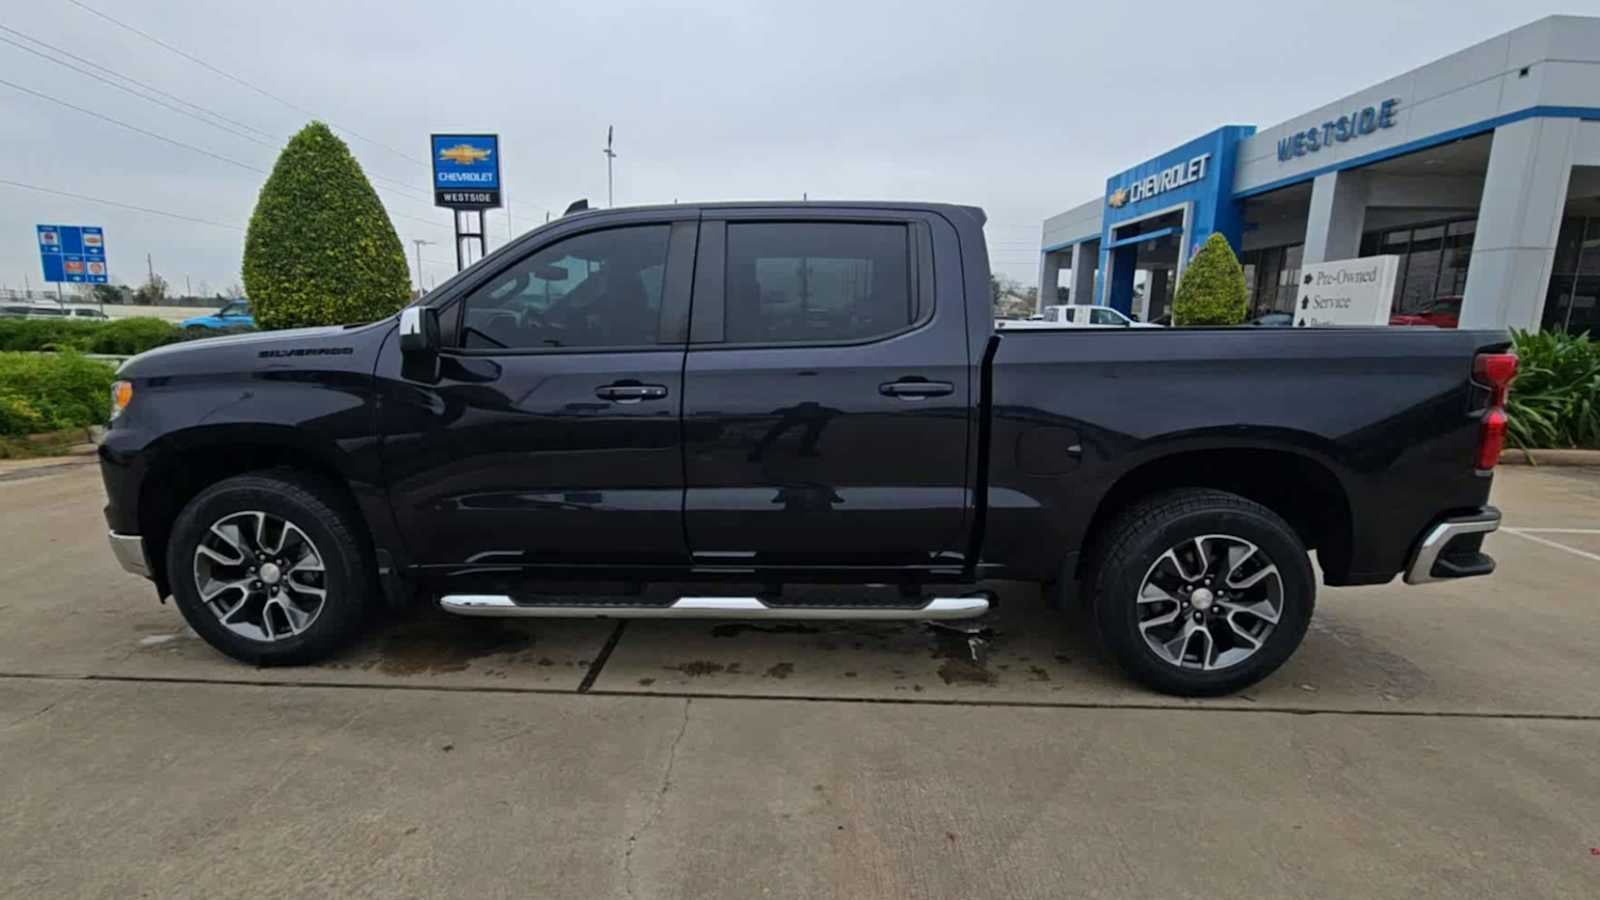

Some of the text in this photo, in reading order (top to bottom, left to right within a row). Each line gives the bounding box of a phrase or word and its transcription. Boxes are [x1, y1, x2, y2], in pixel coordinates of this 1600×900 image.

[1277, 98, 1398, 161] WESTSIDE
[438, 172, 493, 182] CHEVROLET
[1130, 153, 1211, 203] CHEVROLET
[443, 193, 492, 202] WESTSIDE
[1316, 267, 1377, 286] Pre-Owned
[1313, 295, 1351, 309] Service
[258, 347, 354, 358] SILVERADO
